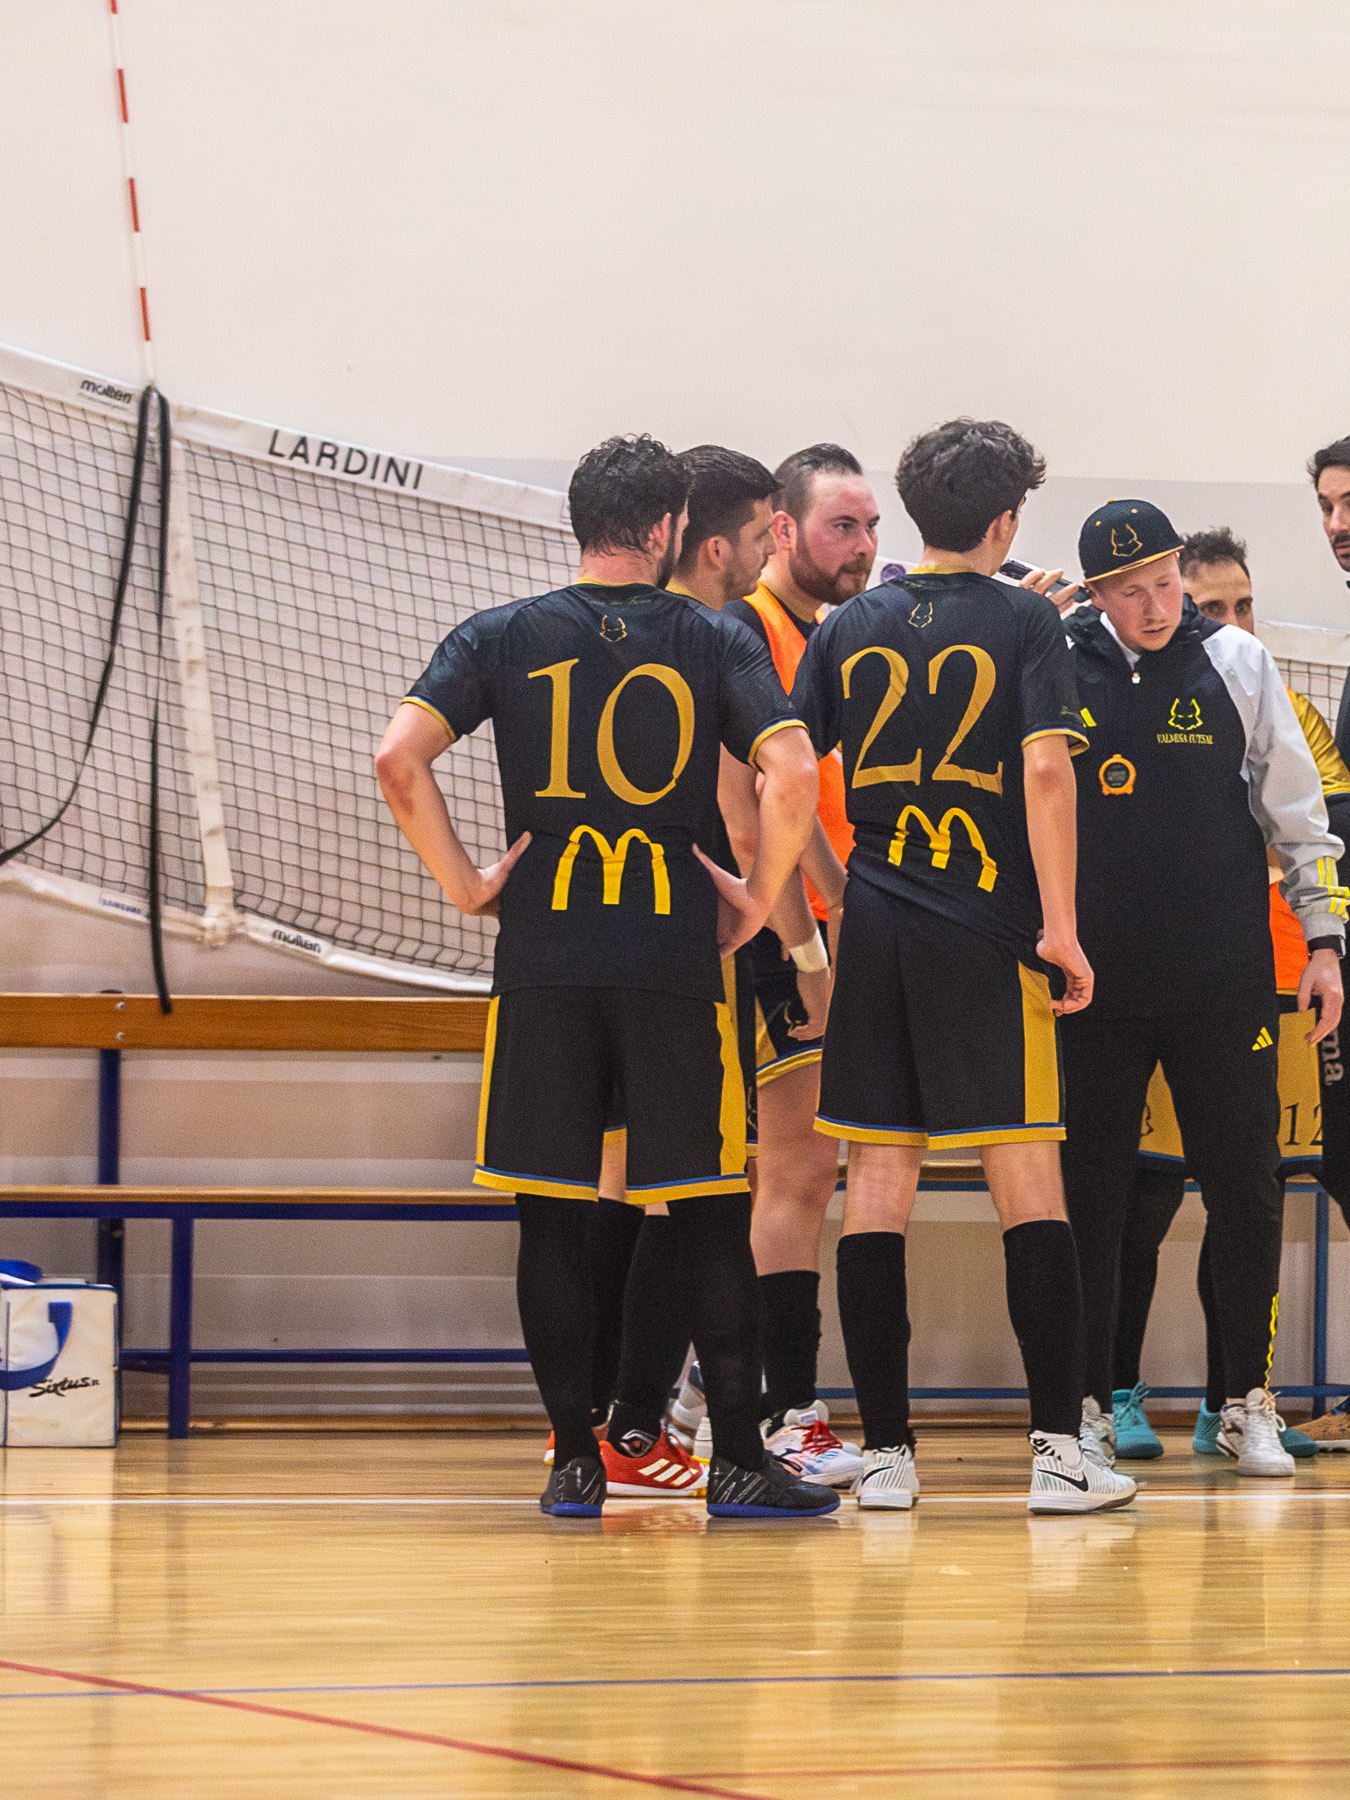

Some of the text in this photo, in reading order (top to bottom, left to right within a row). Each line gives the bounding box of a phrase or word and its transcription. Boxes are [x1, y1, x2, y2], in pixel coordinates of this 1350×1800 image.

[80, 380, 132, 404] molten
[268, 429, 423, 490] LARDINI
[527, 658, 696, 806] 10
[840, 645, 1004, 796] 22
[272, 929, 321, 954] molten
[29, 1377, 90, 1397] Sixtus
